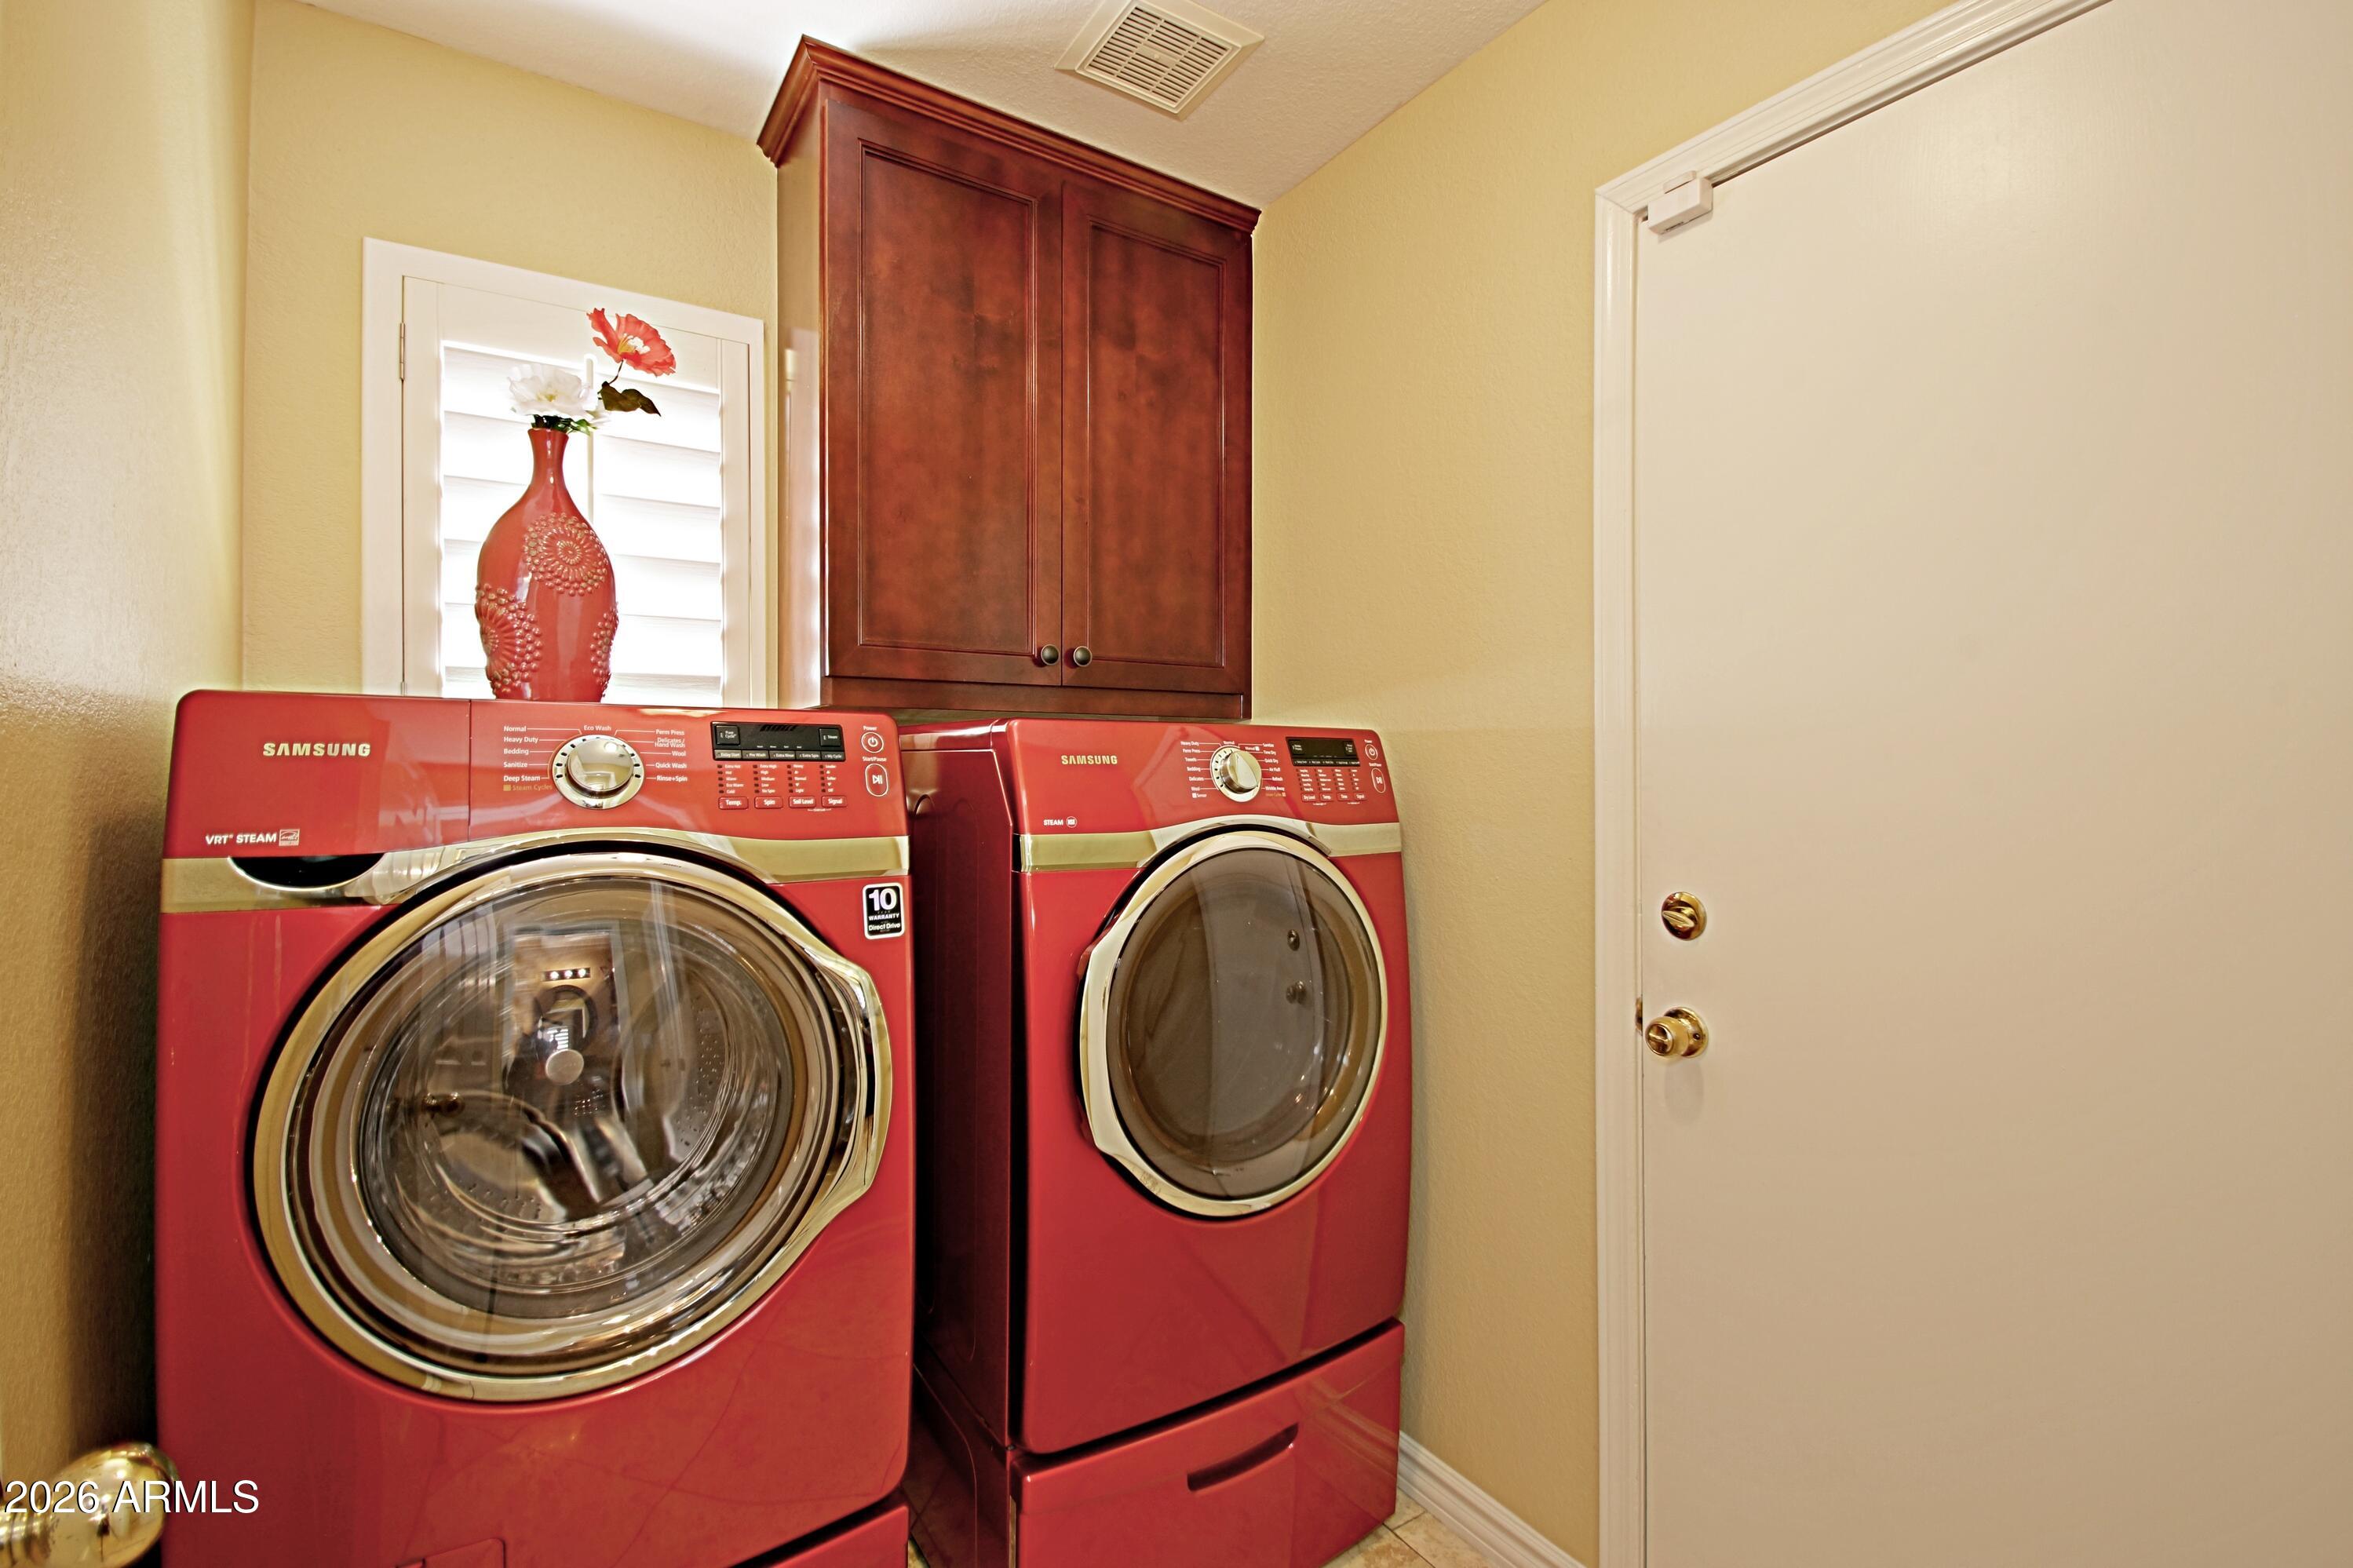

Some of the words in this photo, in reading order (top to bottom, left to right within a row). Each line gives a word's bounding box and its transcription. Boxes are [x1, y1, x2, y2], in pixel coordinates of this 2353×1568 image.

[263, 742, 370, 757] SAMSUNG
[1061, 755, 1118, 765] SAMSUNG
[504, 775, 520, 783] Deep
[236, 833, 277, 844] STEAM
[868, 888, 897, 911] 10
